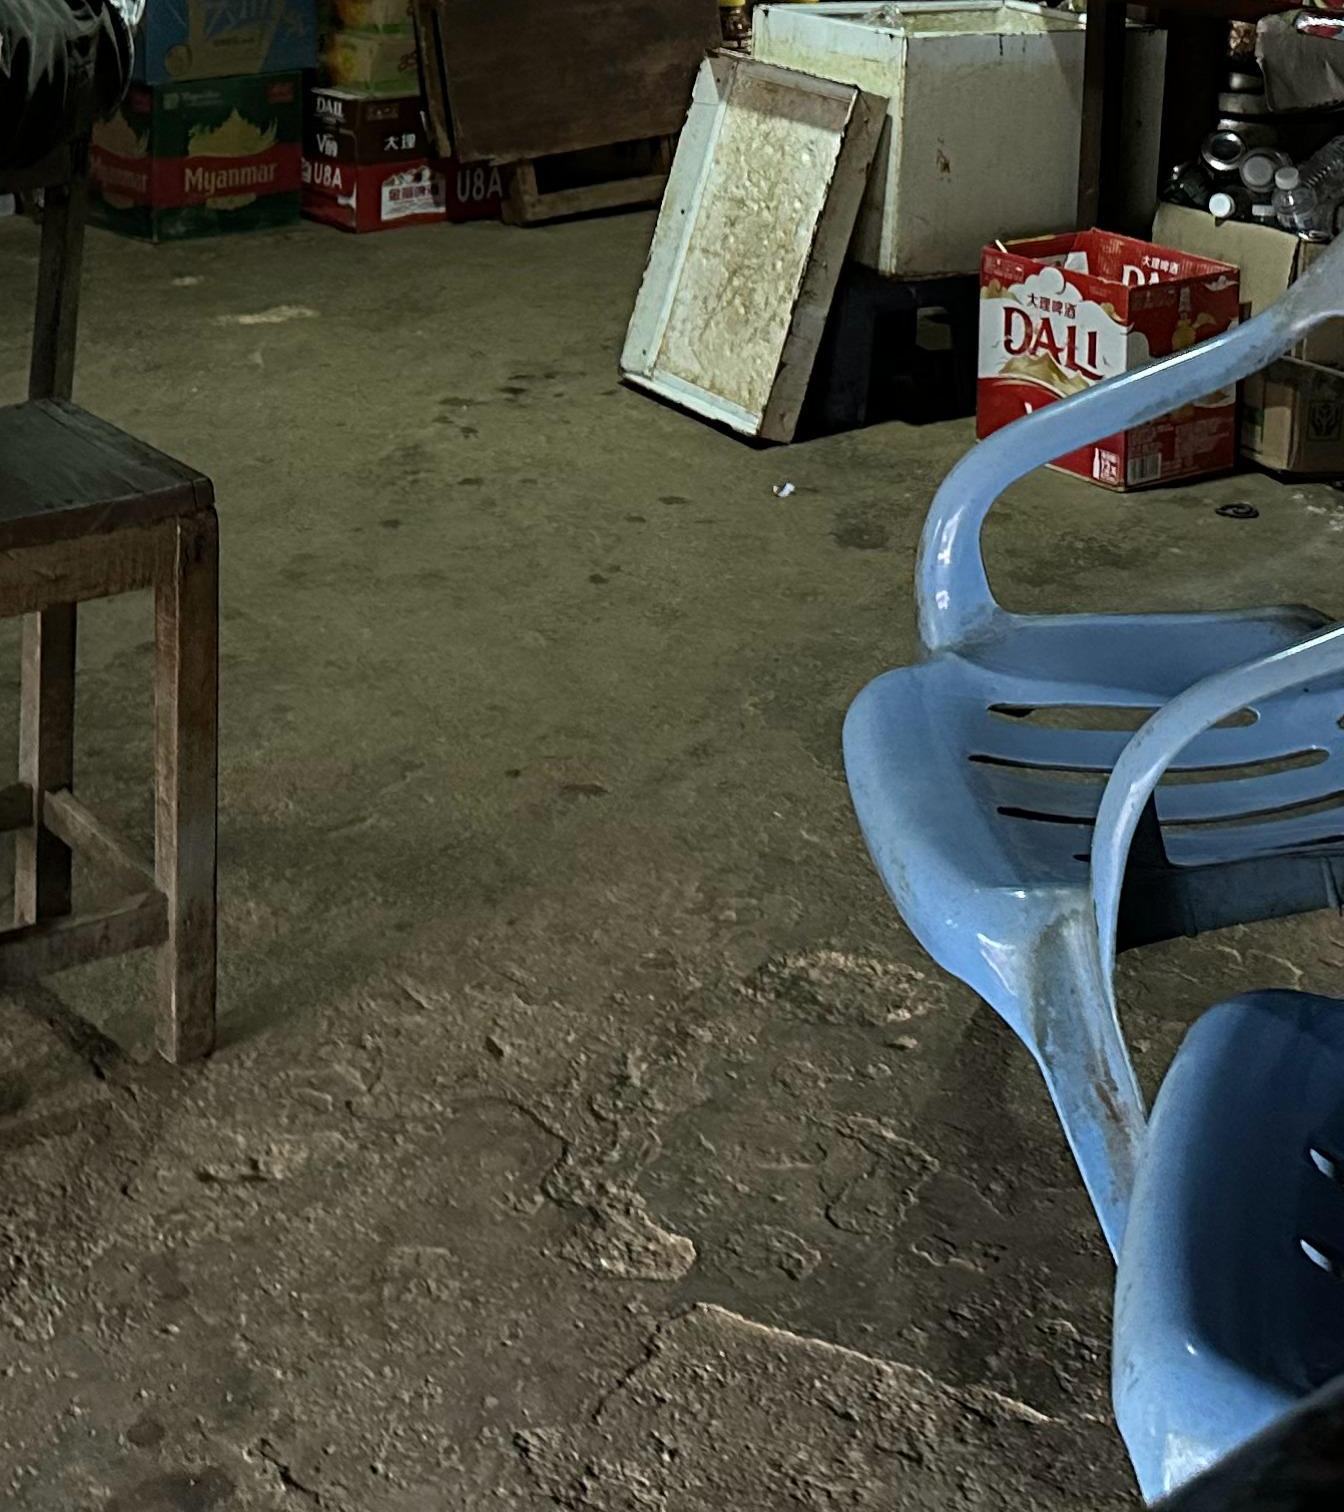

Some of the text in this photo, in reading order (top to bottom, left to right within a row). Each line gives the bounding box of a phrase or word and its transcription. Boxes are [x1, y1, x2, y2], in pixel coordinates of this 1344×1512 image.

[184, 162, 278, 194] Myanmar
[1027, 293, 1077, 320] 大理啤酒
[1003, 307, 1104, 380] DALI
